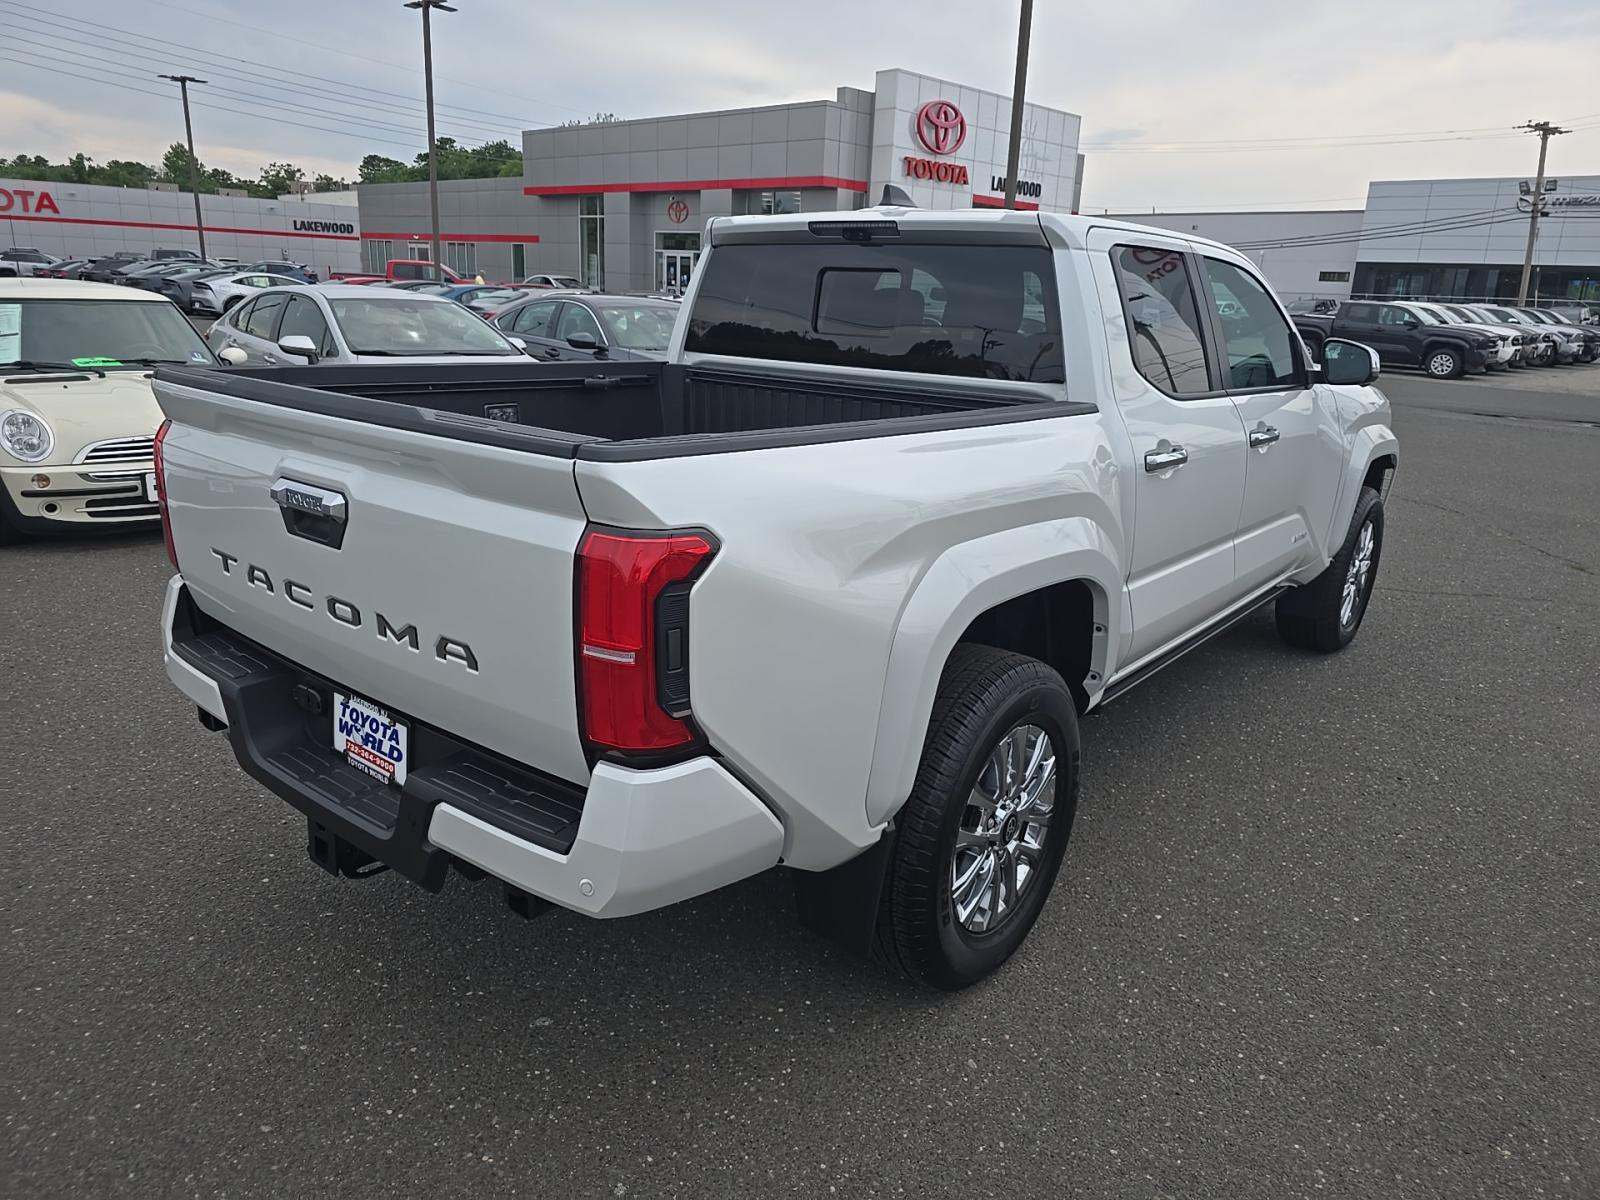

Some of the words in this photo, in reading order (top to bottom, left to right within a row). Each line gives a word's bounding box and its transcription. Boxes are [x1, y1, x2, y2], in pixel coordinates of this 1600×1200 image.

[904, 156, 969, 185] TOYOTA
[991, 175, 1042, 198] LAWOOD
[293, 220, 354, 234] LAKEWOOD
[209, 547, 480, 675] TACOMA
[340, 701, 400, 745] TOYOTA
